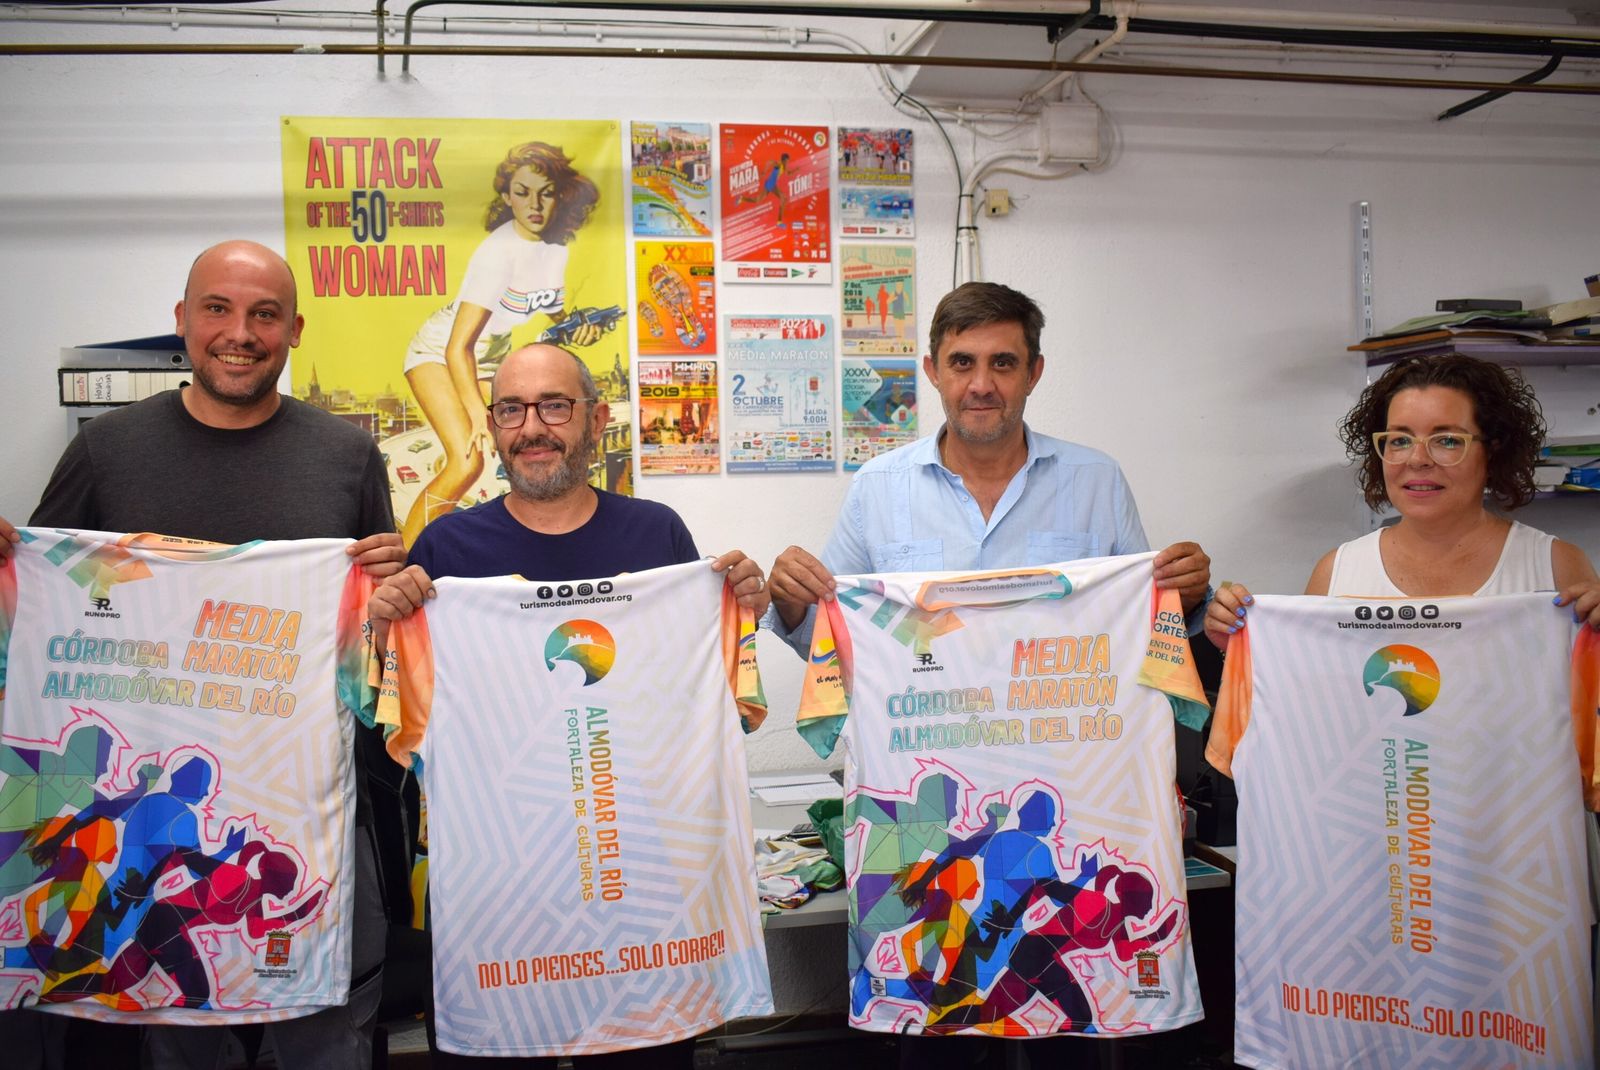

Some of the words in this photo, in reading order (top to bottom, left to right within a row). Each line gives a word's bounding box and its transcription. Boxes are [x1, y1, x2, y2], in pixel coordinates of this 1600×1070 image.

[305, 137, 443, 189] ATTACK
[729, 165, 759, 191] MARA
[306, 201, 324, 227] OF
[325, 202, 350, 227] THE
[351, 190, 388, 243] 50
[388, 201, 444, 227] T-SHIRTS
[307, 245, 447, 297] WOMAN
[780, 319, 808, 328] 2022
[728, 351, 766, 361] MEDIA
[640, 387, 680, 397] 2019
[732, 374, 746, 396] 2
[732, 396, 784, 406] OCTUBRE
[519, 594, 633, 609] turismodealmodovar.org
[193, 599, 302, 650] MEDIA
[1337, 621, 1462, 629] turismodealmodovar.org
[47, 628, 169, 669] CÓRDOBA
[182, 640, 301, 684] MARATÓN
[1011, 633, 1111, 678] MEDIA
[42, 669, 195, 706] ALMODÓVAR
[199, 682, 245, 712] DEL
[250, 684, 298, 718] RÍO
[886, 685, 995, 719] CÓRDOBA
[1007, 671, 1118, 710] MARATÓN
[564, 708, 585, 793] FORTALEZA
[888, 715, 1024, 753] ALMODÓVAR
[1030, 715, 1074, 744] DEL
[1079, 709, 1123, 741] RÍO
[586, 705, 618, 825] ALMODÓVAR
[1381, 738, 1399, 828] FORTALEZA
[573, 799, 587, 818] DE
[1404, 738, 1436, 868] ALMODÓVAR
[577, 825, 594, 902] CULTURAS
[597, 828, 620, 864] DEL
[1387, 835, 1400, 856] DE
[600, 868, 626, 902] RÍO
[1389, 863, 1404, 945] CULTURAS
[1408, 873, 1431, 910] DEL
[1410, 914, 1438, 954] RÍO
[478, 962, 503, 989] NO
[505, 959, 529, 986] LO
[667, 929, 726, 967] CORRE!!
[1282, 983, 1300, 1012] NO
[1305, 987, 1329, 1016] LO
[1478, 1010, 1546, 1056] CORRE!!
